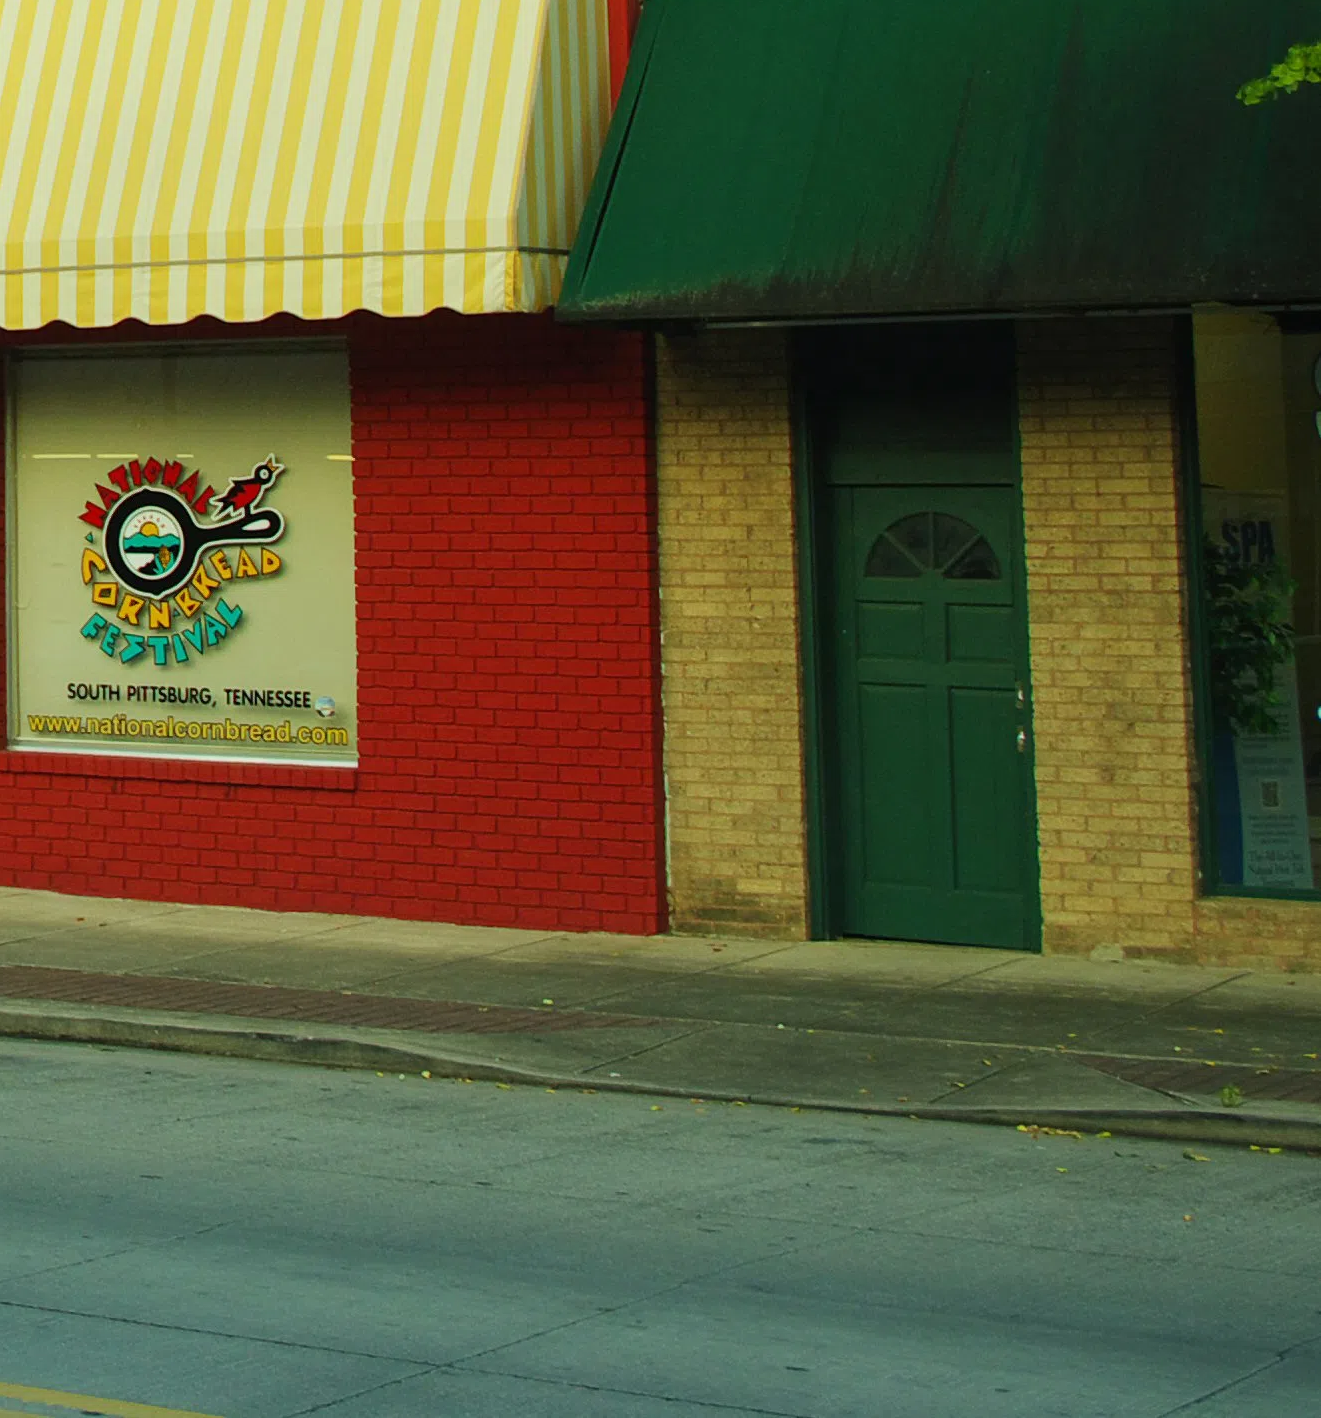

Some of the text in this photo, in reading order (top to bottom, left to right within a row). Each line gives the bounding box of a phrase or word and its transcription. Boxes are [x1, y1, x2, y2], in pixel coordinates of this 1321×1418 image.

[78, 456, 219, 530] NATIONAL
[1221, 519, 1276, 565] SPA
[81, 547, 282, 629] CORNBREAD
[80, 598, 244, 666] FESTIVAL
[67, 683, 312, 709] SOUTH PITTSBURG, TENNESSEE
[28, 714, 349, 746] www.nationalcornbread.com
